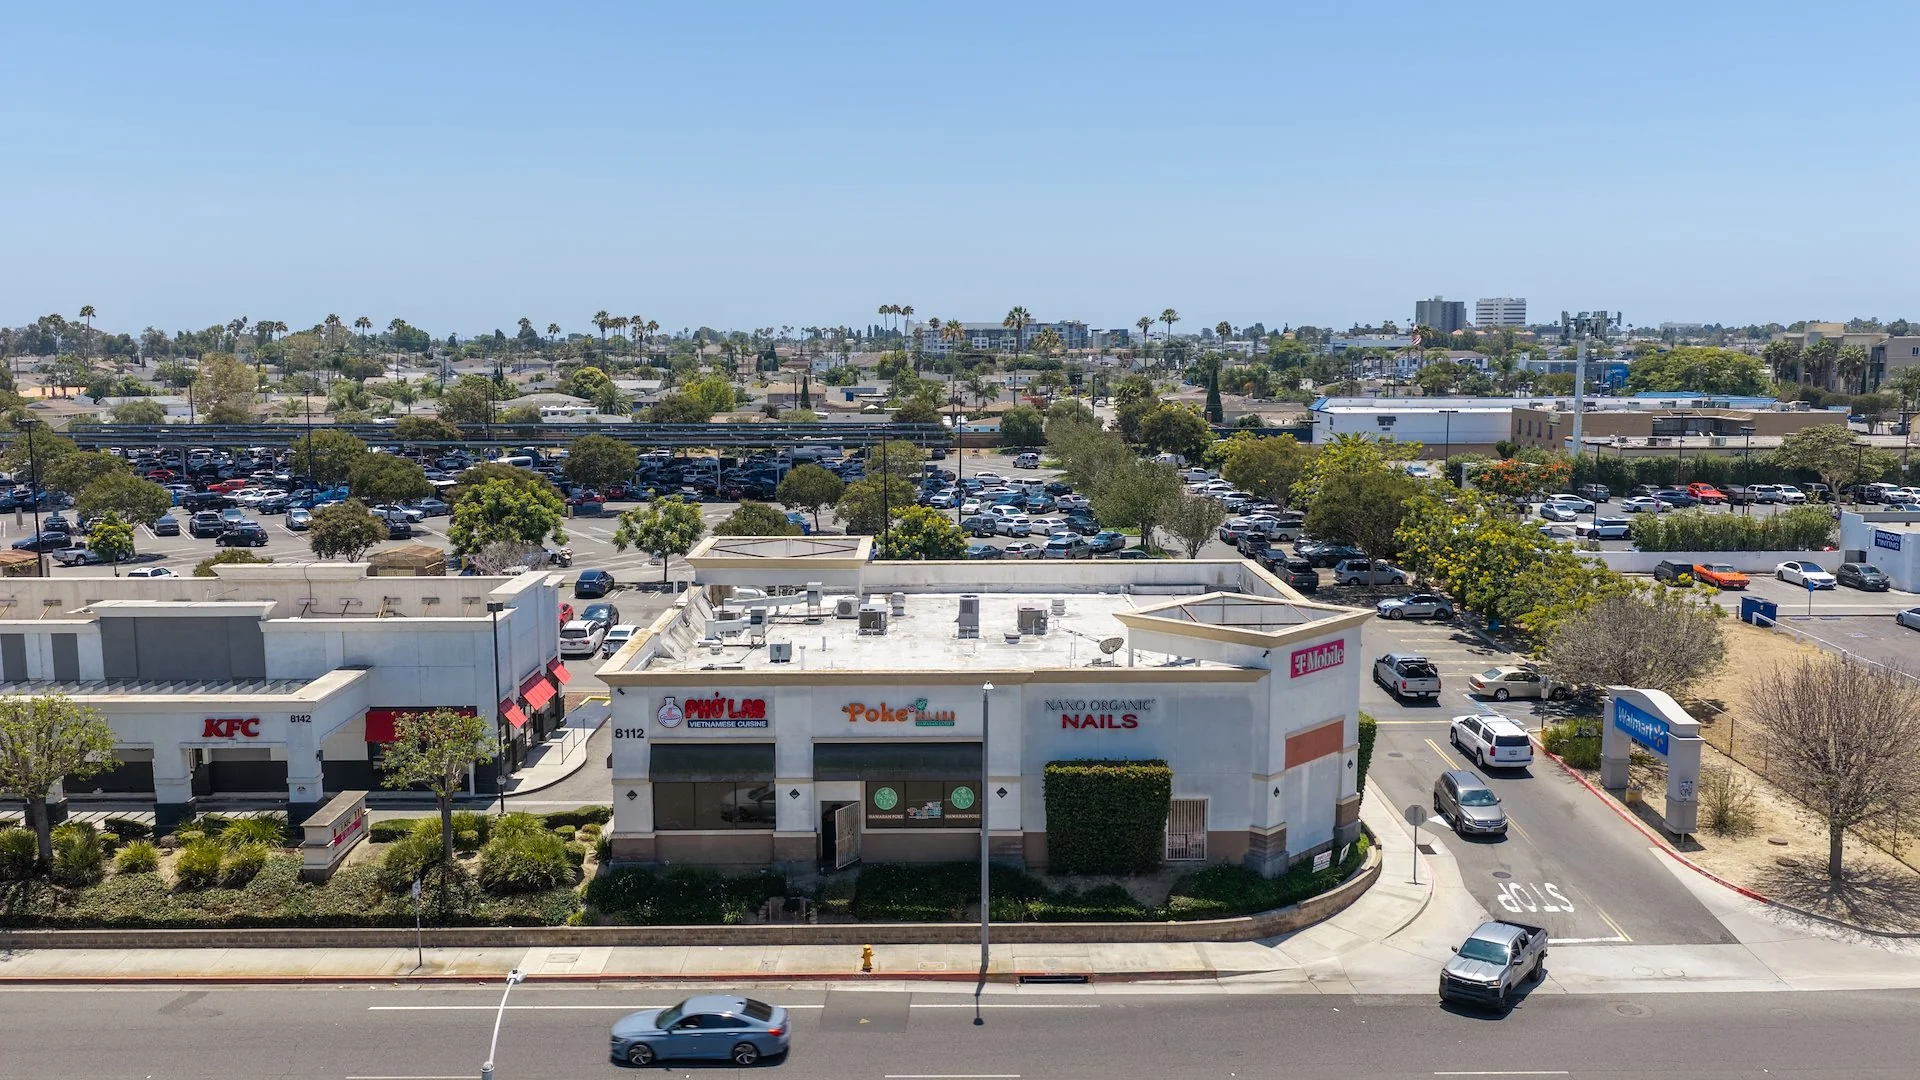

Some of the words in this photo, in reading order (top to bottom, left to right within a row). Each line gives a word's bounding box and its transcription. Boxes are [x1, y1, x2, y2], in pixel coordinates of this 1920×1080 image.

[1876, 531, 1900, 542] WINDOW
[1876, 538, 1899, 550] TINTING
[727, 698, 766, 719] LAB
[1045, 699, 1086, 711] NANO
[290, 715, 311, 723] 8142
[849, 702, 909, 723] Poke
[202, 717, 260, 738] KFC
[689, 720, 737, 728] VIETNAMESE
[737, 720, 767, 728] CUISINE
[1062, 713, 1138, 729] NAILS
[1618, 706, 1653, 740] Walmart
[615, 728, 645, 739] 8112
[1497, 882, 1575, 913] STOP
